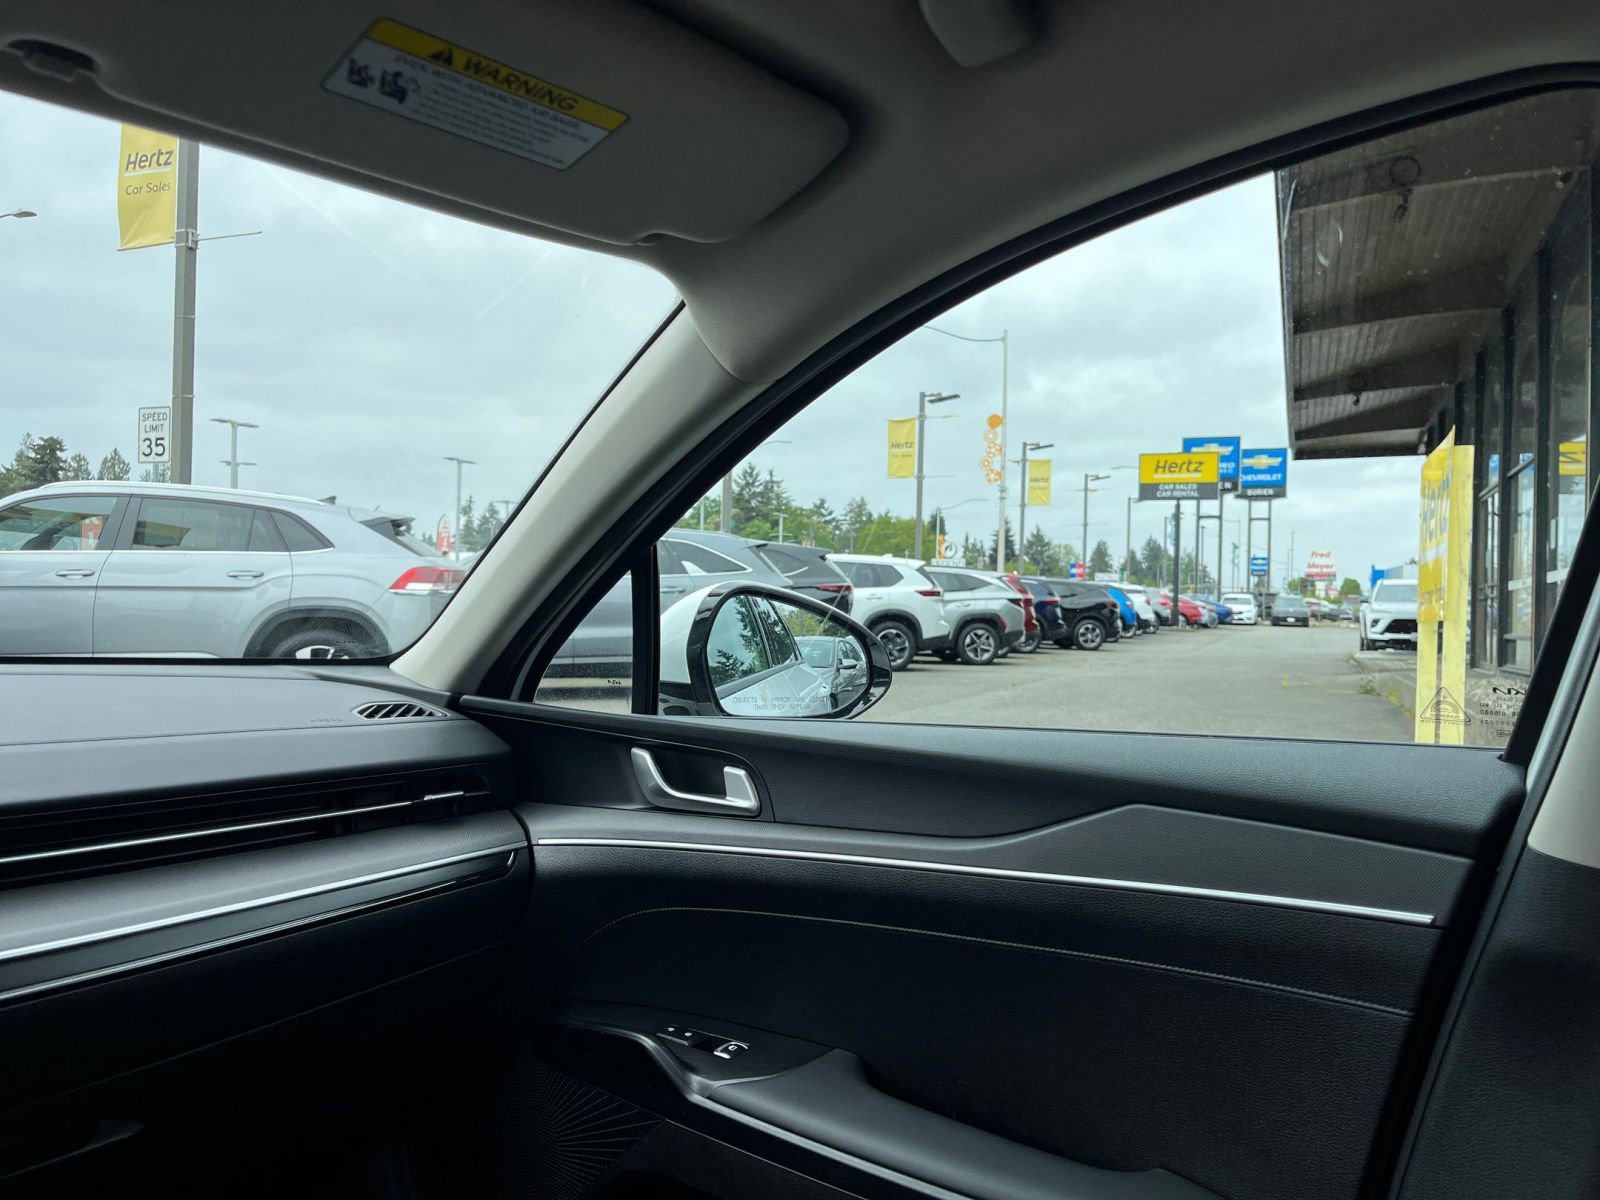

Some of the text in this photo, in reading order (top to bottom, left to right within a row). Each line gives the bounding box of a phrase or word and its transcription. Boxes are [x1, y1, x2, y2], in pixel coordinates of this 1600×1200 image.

[463, 55, 579, 111] WARNING
[125, 149, 174, 171] Hertz
[125, 181, 171, 195] Car Sales
[142, 411, 168, 422] SPEED
[144, 424, 164, 433] LIMIT
[142, 437, 166, 457] 35
[890, 441, 914, 450] Hertz
[1154, 459, 1205, 474] Hertz
[1240, 473, 1282, 482] CHEVROLET
[1157, 490, 1172, 498] CAR
[1247, 488, 1274, 496] BURIEN
